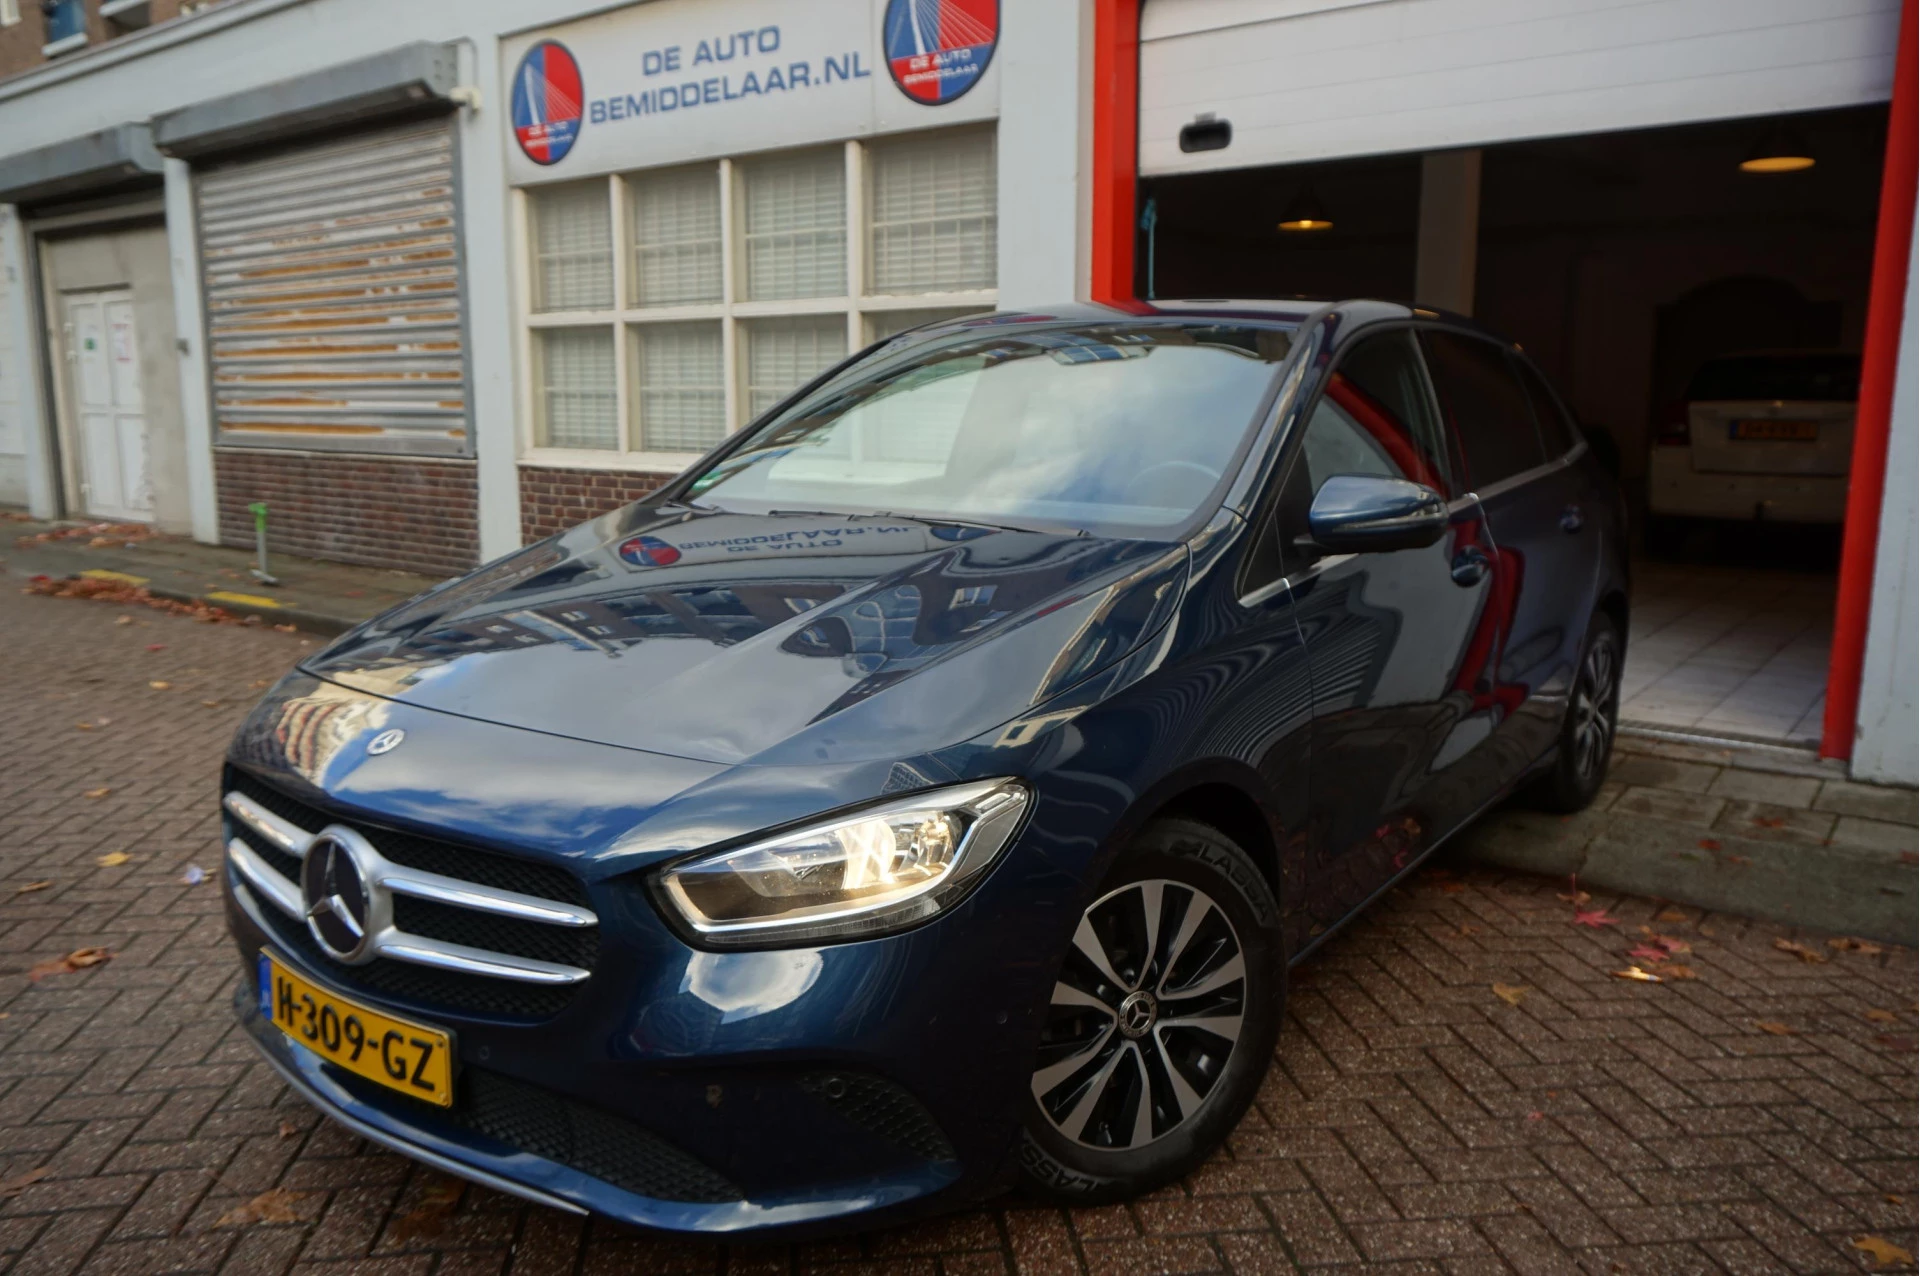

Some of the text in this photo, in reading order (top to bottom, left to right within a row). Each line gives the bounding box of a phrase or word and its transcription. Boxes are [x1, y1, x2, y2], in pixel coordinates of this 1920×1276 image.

[641, 25, 781, 77] DE AUTO
[909, 48, 972, 70] DE AUTO
[589, 51, 872, 125] BEMIDDELAAR.NL
[277, 975, 436, 1092] H-309-GZ
